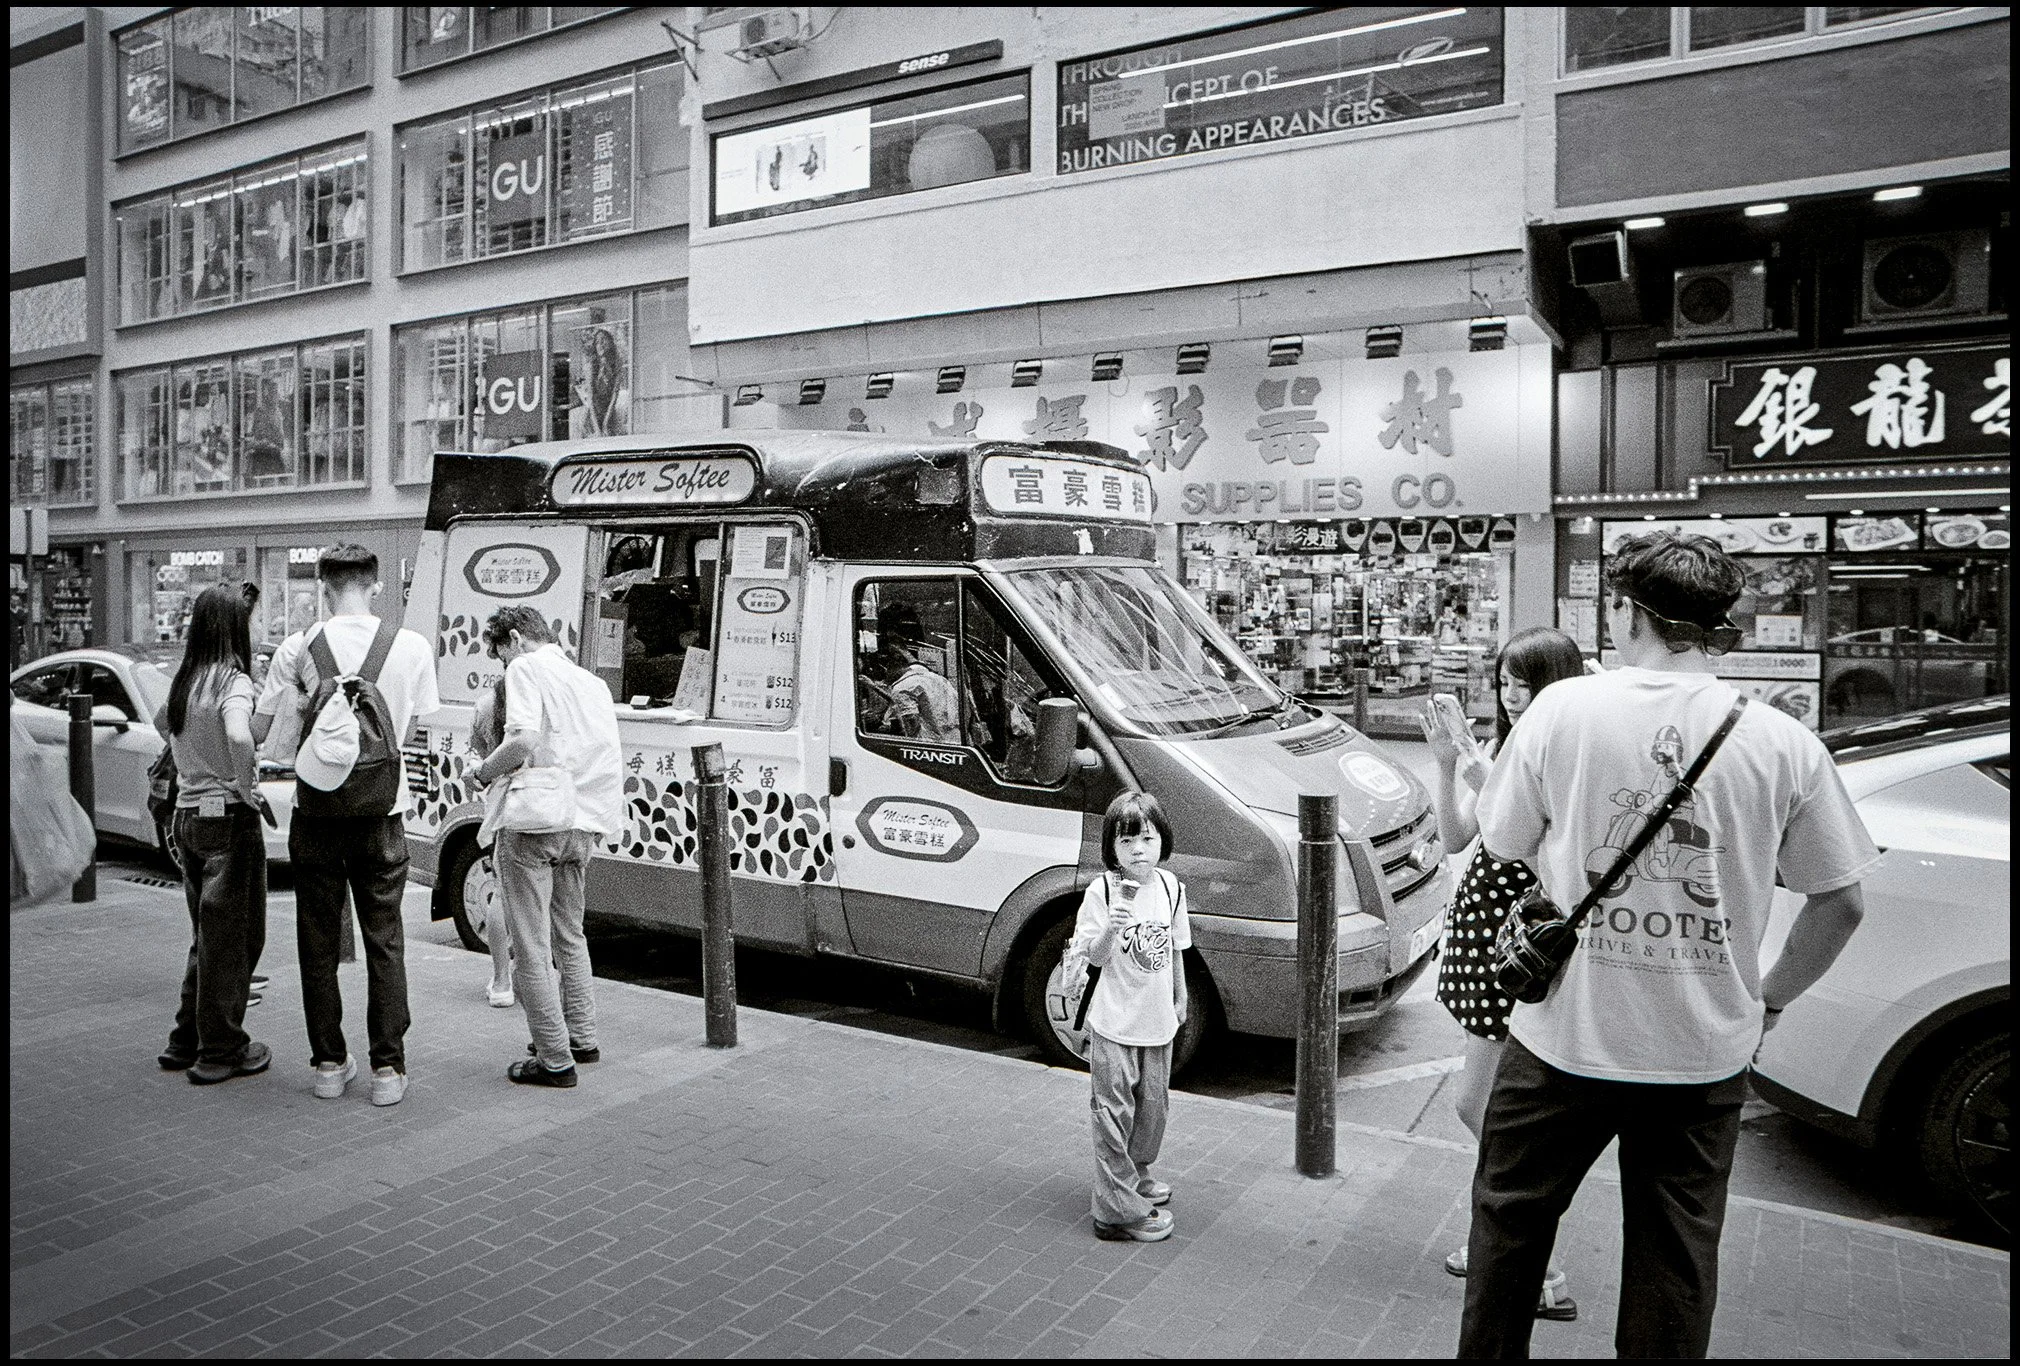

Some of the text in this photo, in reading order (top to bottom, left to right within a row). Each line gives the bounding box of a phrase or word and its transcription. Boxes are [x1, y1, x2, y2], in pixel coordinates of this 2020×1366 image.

[898, 53, 949, 74] sense
[1061, 65, 1279, 127] TH CEPT OF
[1061, 98, 1386, 173] BURNING APPEARANCES
[492, 155, 543, 201] GU
[488, 375, 541, 415] GU
[571, 462, 731, 499] Mister Softee
[1008, 463, 1147, 515] 富豪雪糕
[1181, 476, 1363, 515] SUPPLIES
[1391, 472, 1464, 510] CO.
[900, 747, 966, 766] TRANSIT
[884, 826, 945, 848] 富豪雪糕
[1643, 944, 1655, 957] &
